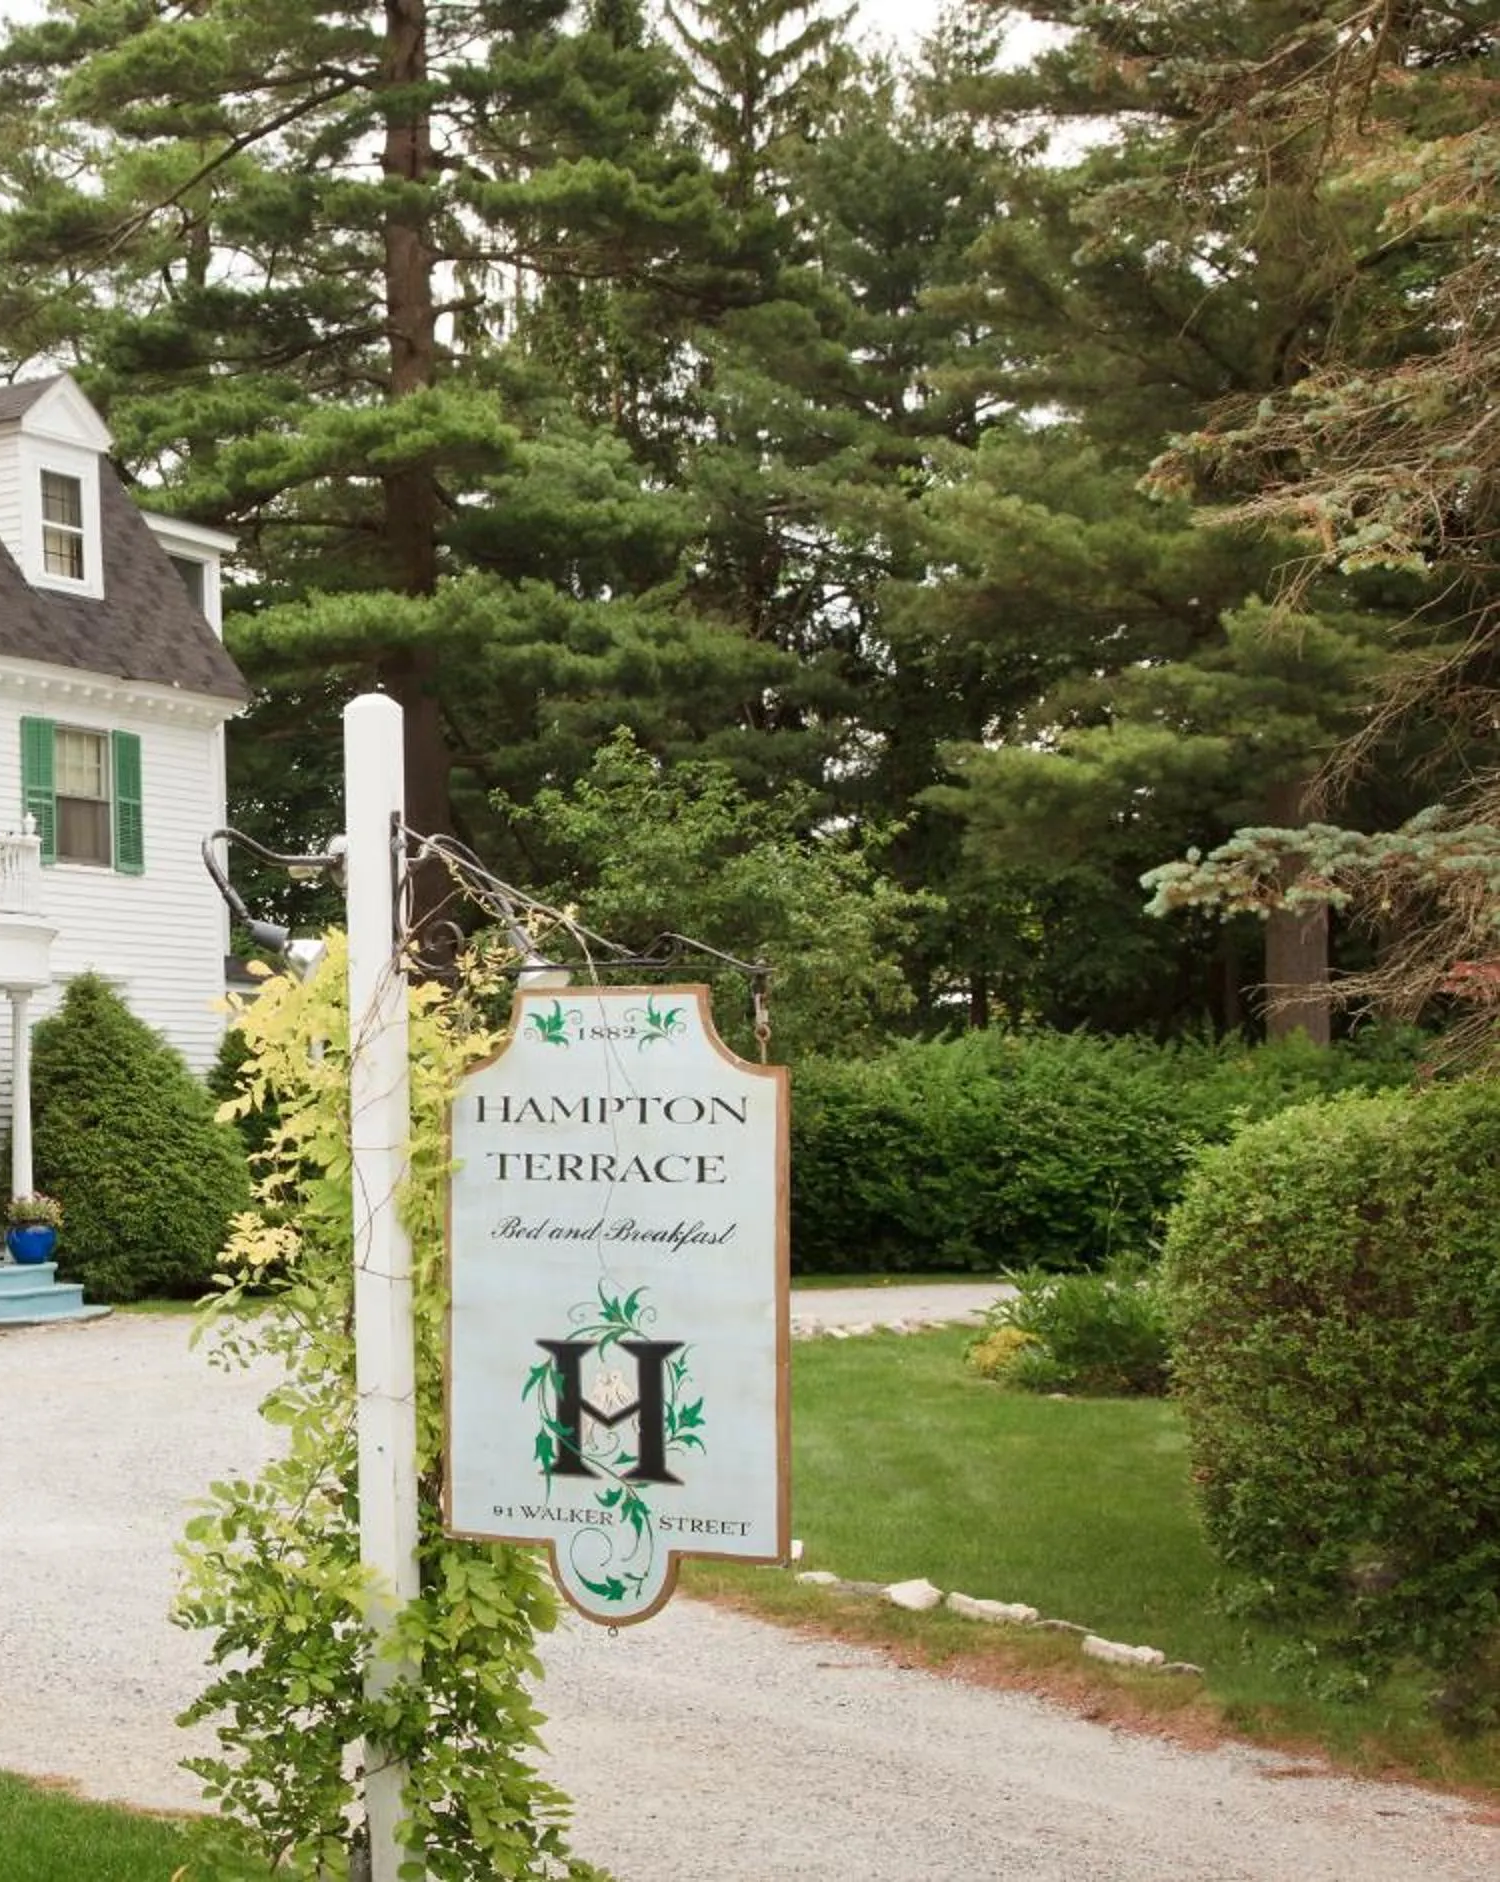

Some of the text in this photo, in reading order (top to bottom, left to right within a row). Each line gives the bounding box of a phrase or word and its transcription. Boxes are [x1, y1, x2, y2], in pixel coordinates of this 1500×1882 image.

[475, 1094, 748, 1125] HAMPTON
[486, 1152, 727, 1184] TERRACE
[491, 1214, 738, 1253] Bed and Breakfast
[518, 1504, 614, 1526] WALKER
[658, 1514, 751, 1537] STREET
